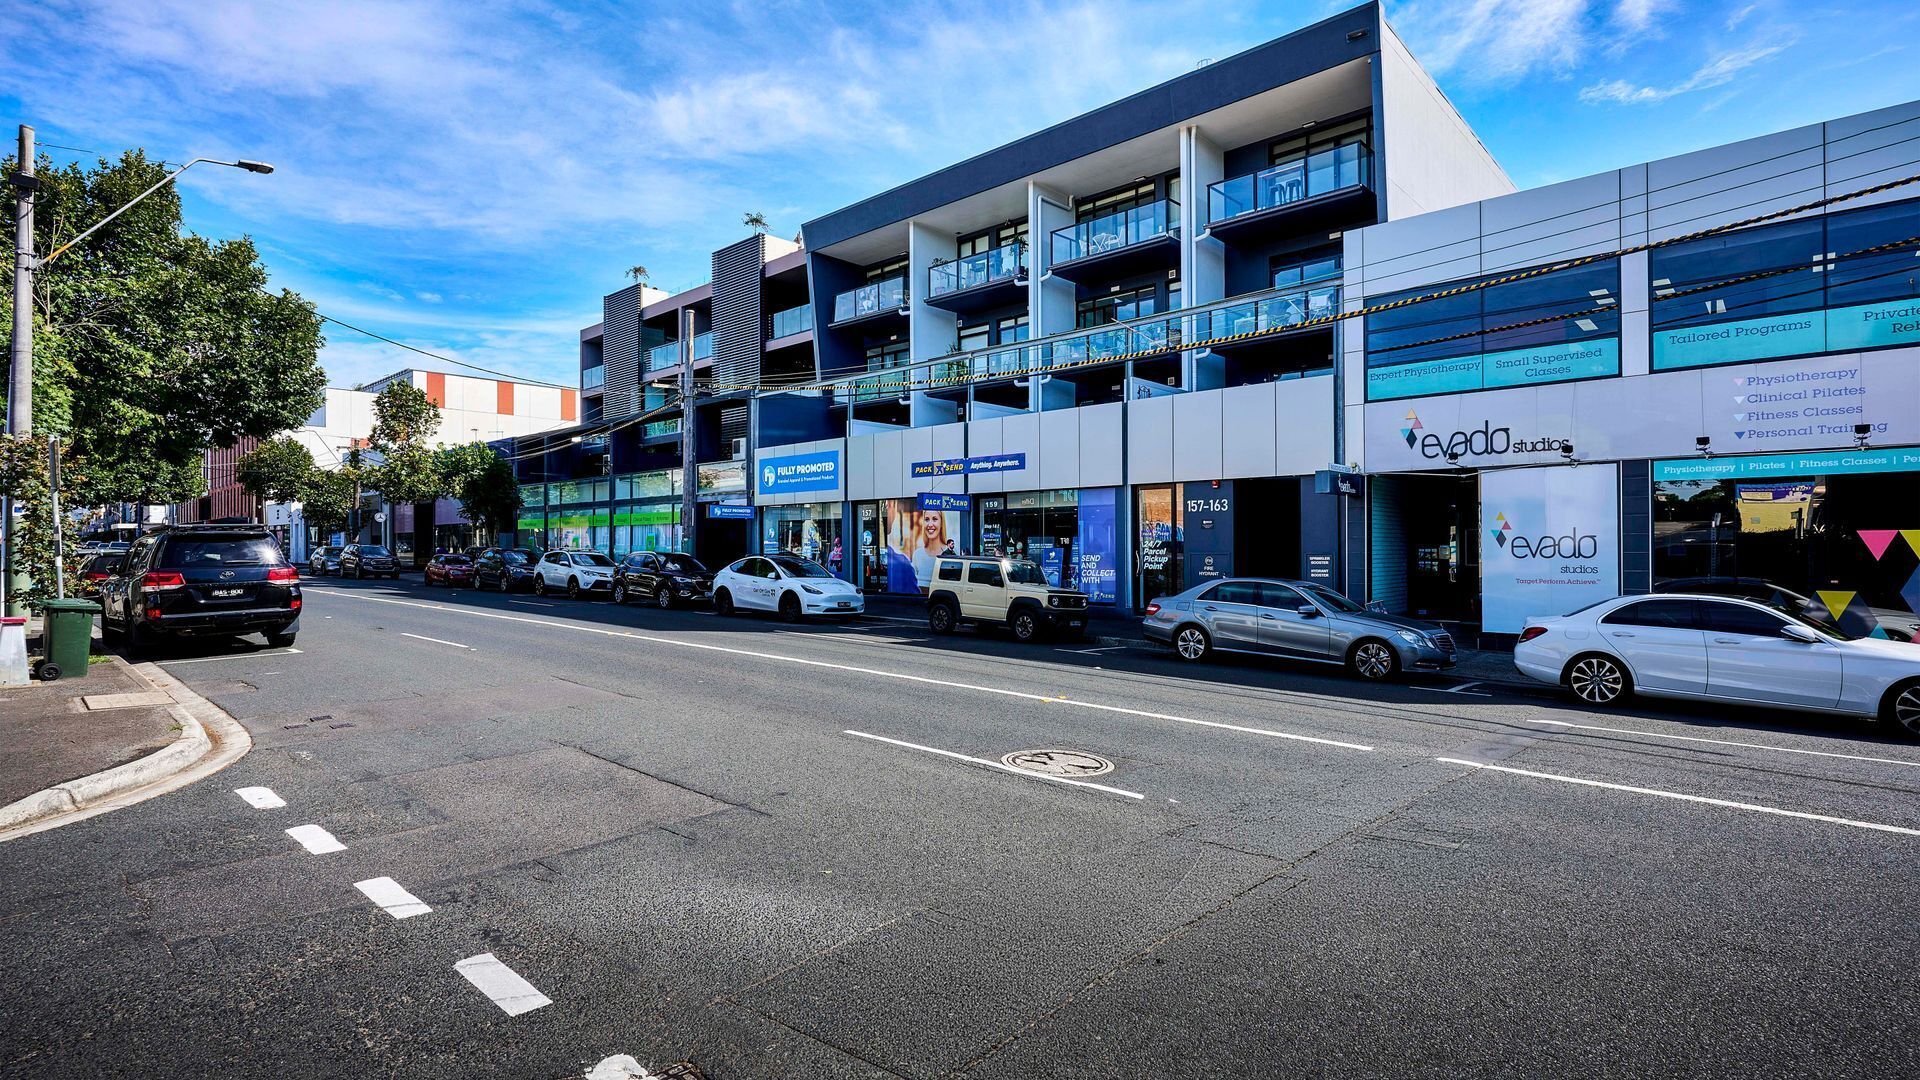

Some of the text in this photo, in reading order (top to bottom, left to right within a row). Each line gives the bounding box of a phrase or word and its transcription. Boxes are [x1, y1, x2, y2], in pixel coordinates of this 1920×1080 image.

[1669, 320, 1812, 344] Tailored Programs
[1496, 348, 1602, 369] Small Supervised
[1370, 360, 1481, 382] Expert Physiotherapy
[1525, 364, 1572, 378] Classes
[1747, 368, 1858, 386] Physiotherapy
[1748, 386, 1866, 404] Clinical Pilates
[1748, 404, 1863, 422] Fitness Classes
[1422, 420, 1510, 458] evado
[1748, 422, 1888, 439] Personal Traing
[778, 462, 835, 476] FULLY PROMOTED
[1664, 464, 1736, 475] Physiotherapy
[1749, 461, 1786, 470] Pilates
[1800, 458, 1840, 468] Fitness
[1842, 458, 1887, 466] Classes
[1187, 499, 1228, 512] 157-163
[1511, 527, 1597, 559] evado
[1561, 565, 1598, 574] studios
